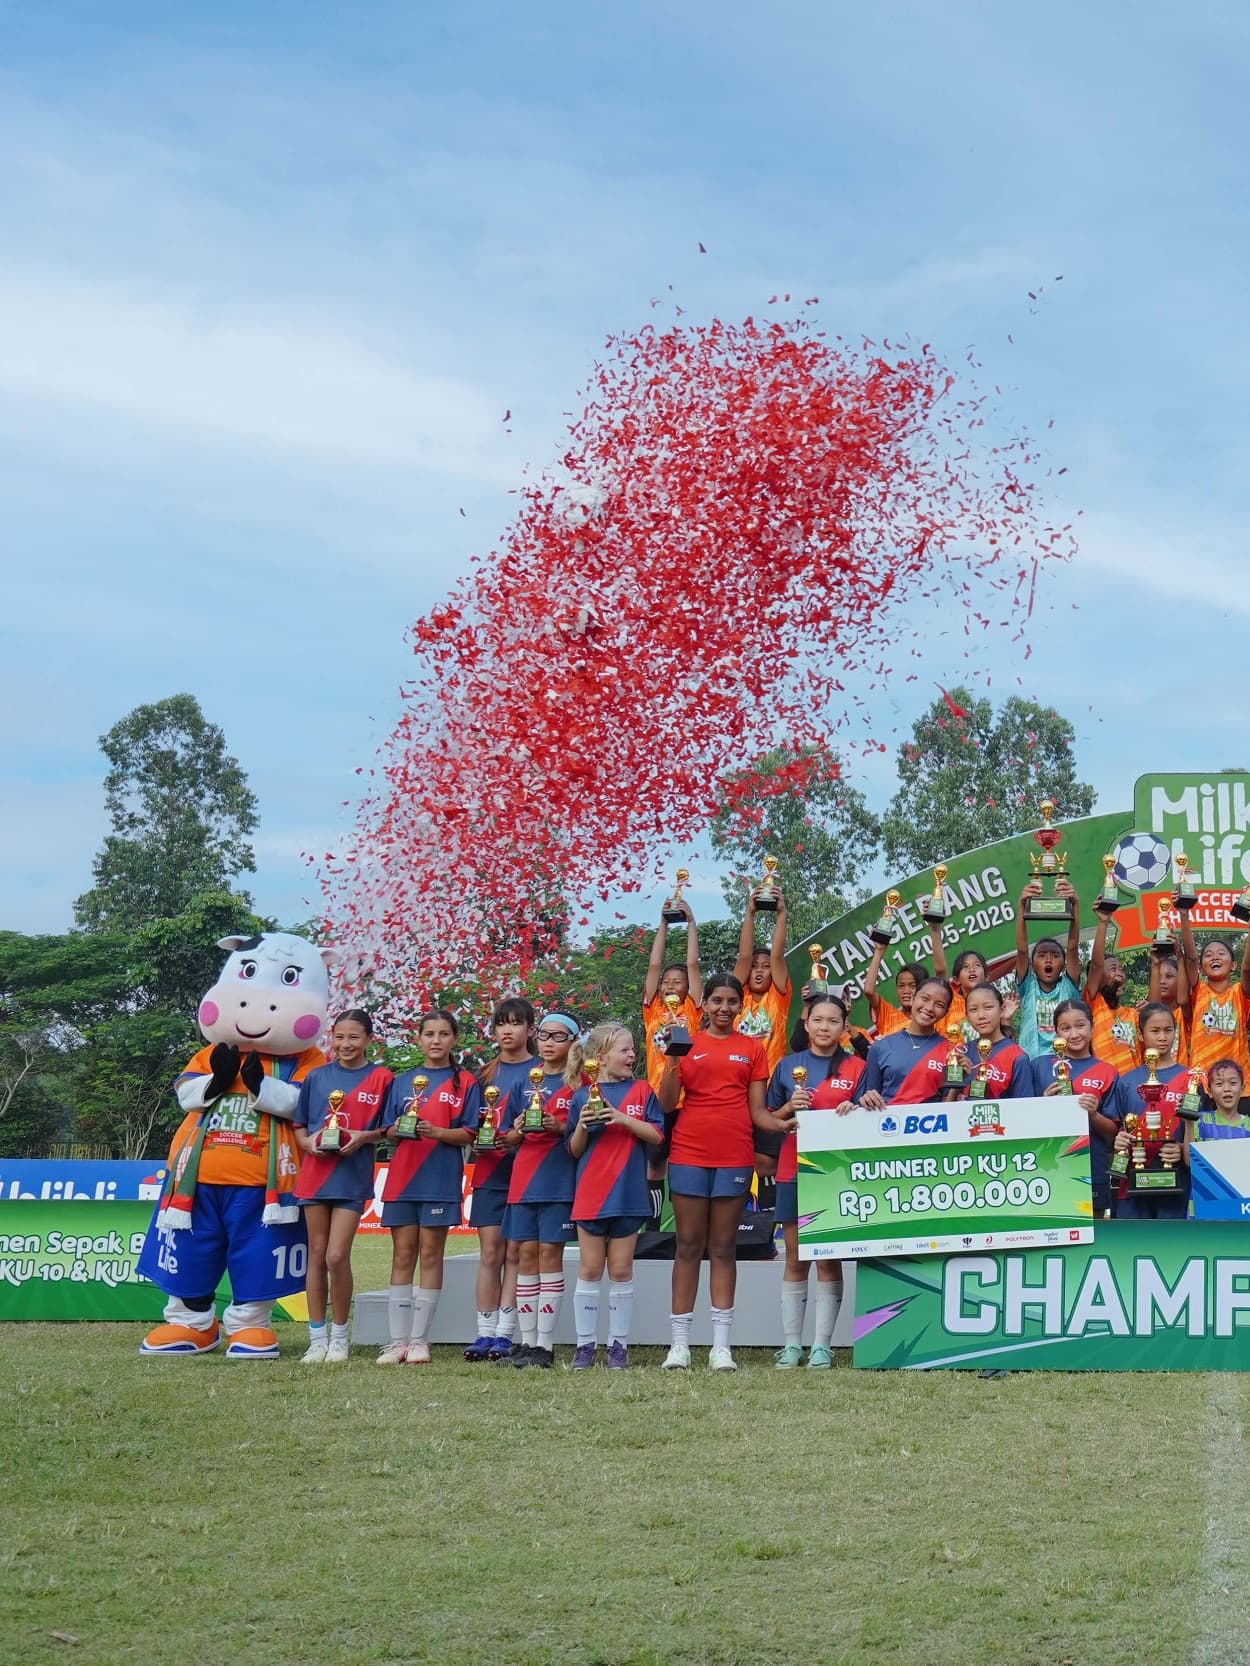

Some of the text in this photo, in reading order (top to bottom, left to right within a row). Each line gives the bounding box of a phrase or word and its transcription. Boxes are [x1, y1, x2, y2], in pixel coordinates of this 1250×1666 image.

[909, 900, 1015, 962] 205-2026
[893, 951, 906, 966] 1
[830, 1079, 854, 1090] BSJ
[219, 1097, 257, 1117] Milk
[358, 1091, 379, 1105] BSJ
[439, 1092, 462, 1108] BSJ
[556, 1098, 571, 1109] BS
[1165, 1091, 1184, 1105] BS
[975, 1105, 997, 1116] Milk
[979, 1115, 999, 1125] Life
[221, 1113, 256, 1133] Life
[904, 1114, 948, 1134] BCA
[851, 1152, 1037, 1181] RUNNER UP KU 12
[839, 1177, 1051, 1222] Rp 1.800.000
[47, 1231, 123, 1259] Sepak
[272, 1243, 307, 1279] 10
[0, 1259, 34, 1286] KU
[39, 1263, 64, 1281] 10
[70, 1260, 89, 1283] &
[95, 1260, 130, 1287] KU
